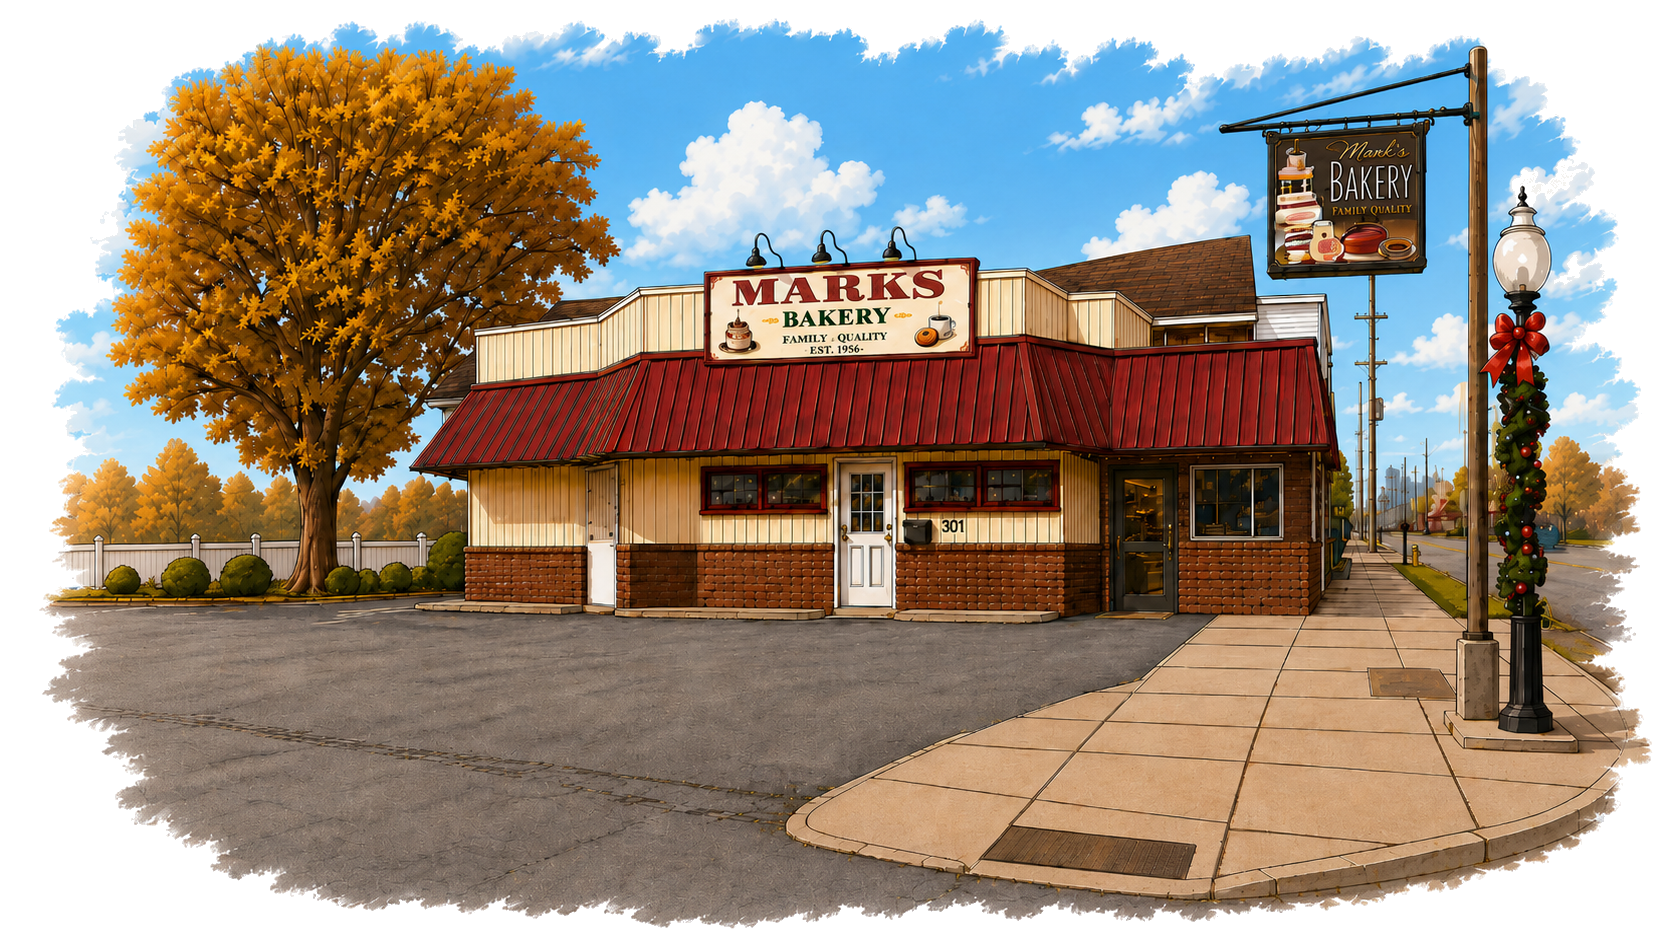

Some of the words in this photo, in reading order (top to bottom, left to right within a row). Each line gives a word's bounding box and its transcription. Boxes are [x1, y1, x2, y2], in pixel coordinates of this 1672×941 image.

[1330, 161, 1413, 202] BAKERY
[1332, 206, 1367, 216] FAMILY
[1370, 204, 1412, 216] QUALITY
[732, 269, 945, 306] MARKS
[782, 307, 891, 328] BAKERY
[782, 334, 828, 344] FAMILY
[837, 332, 888, 343] QUALITY
[942, 519, 964, 532] 301
